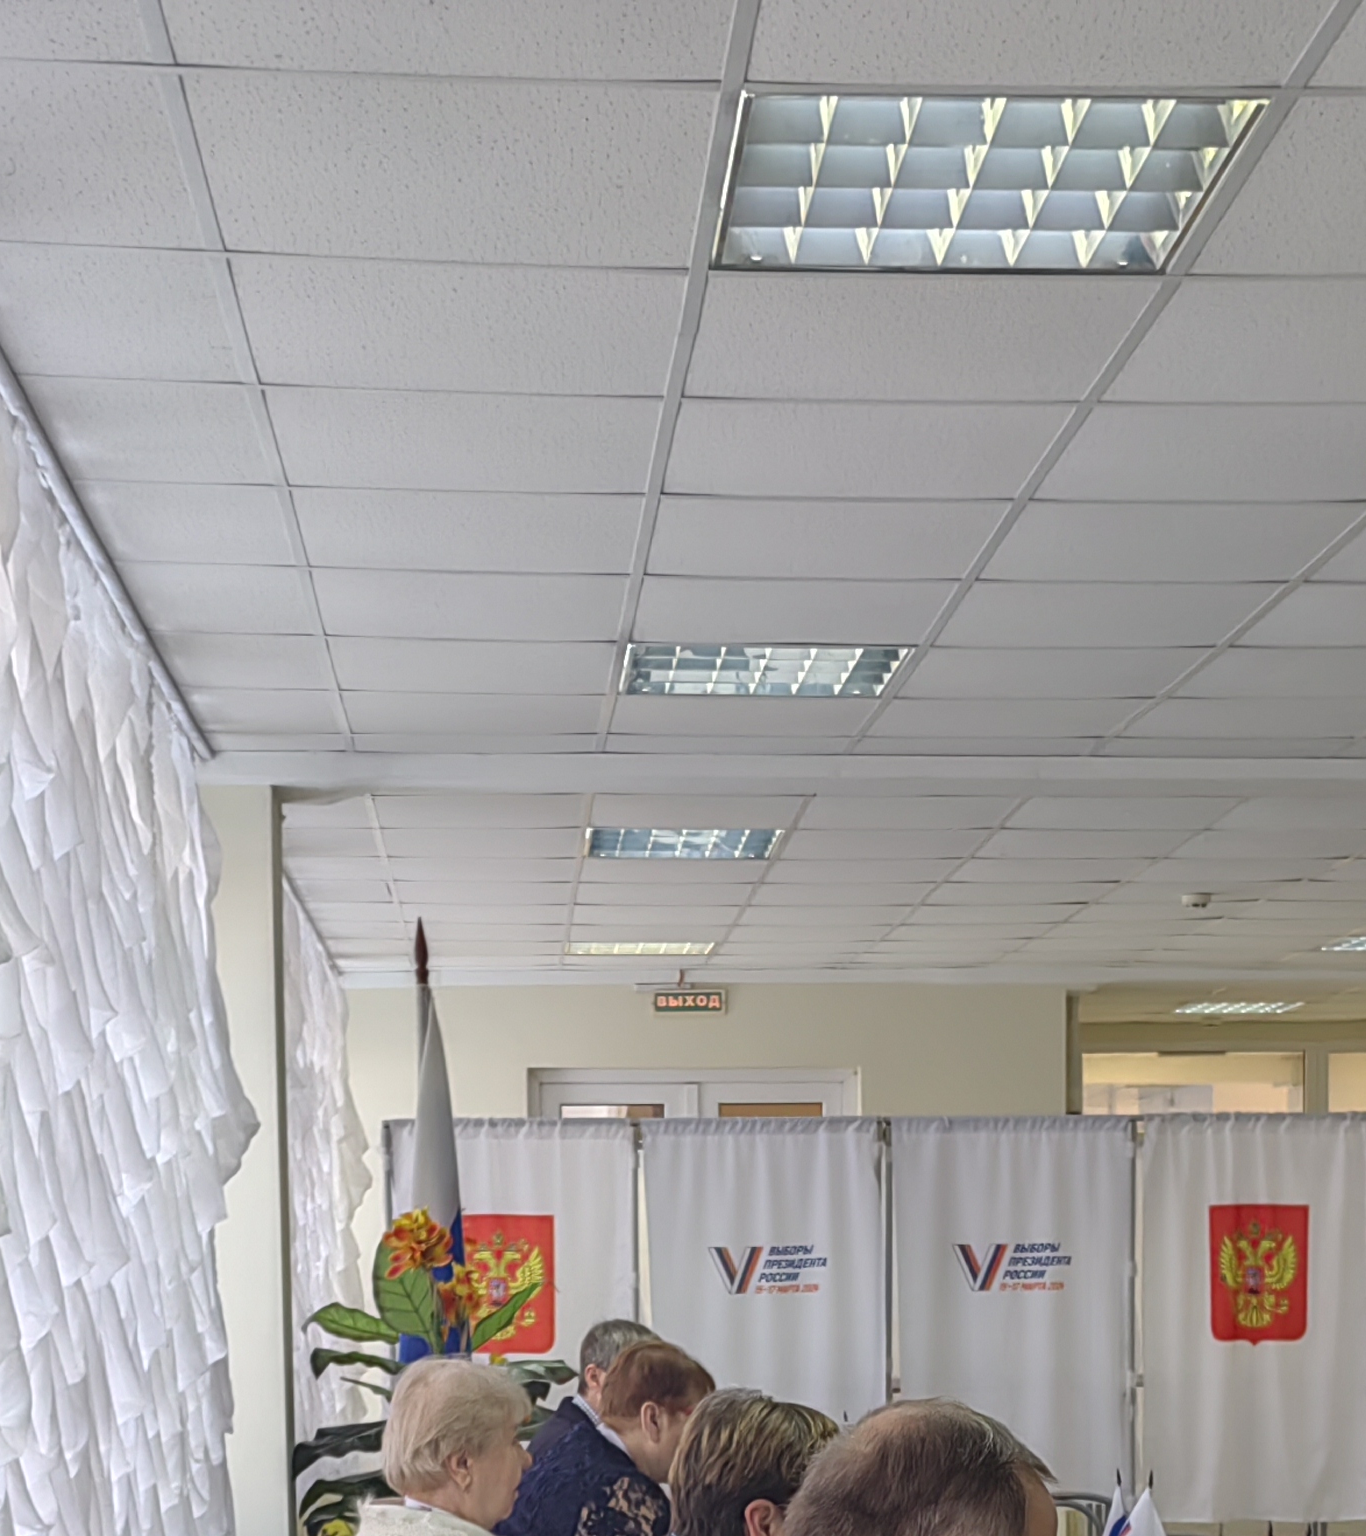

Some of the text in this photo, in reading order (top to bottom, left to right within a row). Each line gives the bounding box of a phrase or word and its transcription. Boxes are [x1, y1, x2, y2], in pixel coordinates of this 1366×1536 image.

[656, 995, 721, 1008] ВЫХОД
[768, 1244, 814, 1256] ВЫБОРЫ
[1012, 1242, 1062, 1254] ВЫБОРЫ
[762, 1257, 828, 1270] ПРЕЗИДЕНТА
[1008, 1256, 1073, 1267] ПРЕЗИДЕНТА
[757, 1272, 800, 1283] РОССИИ
[1002, 1269, 1047, 1281] РОССИИ
